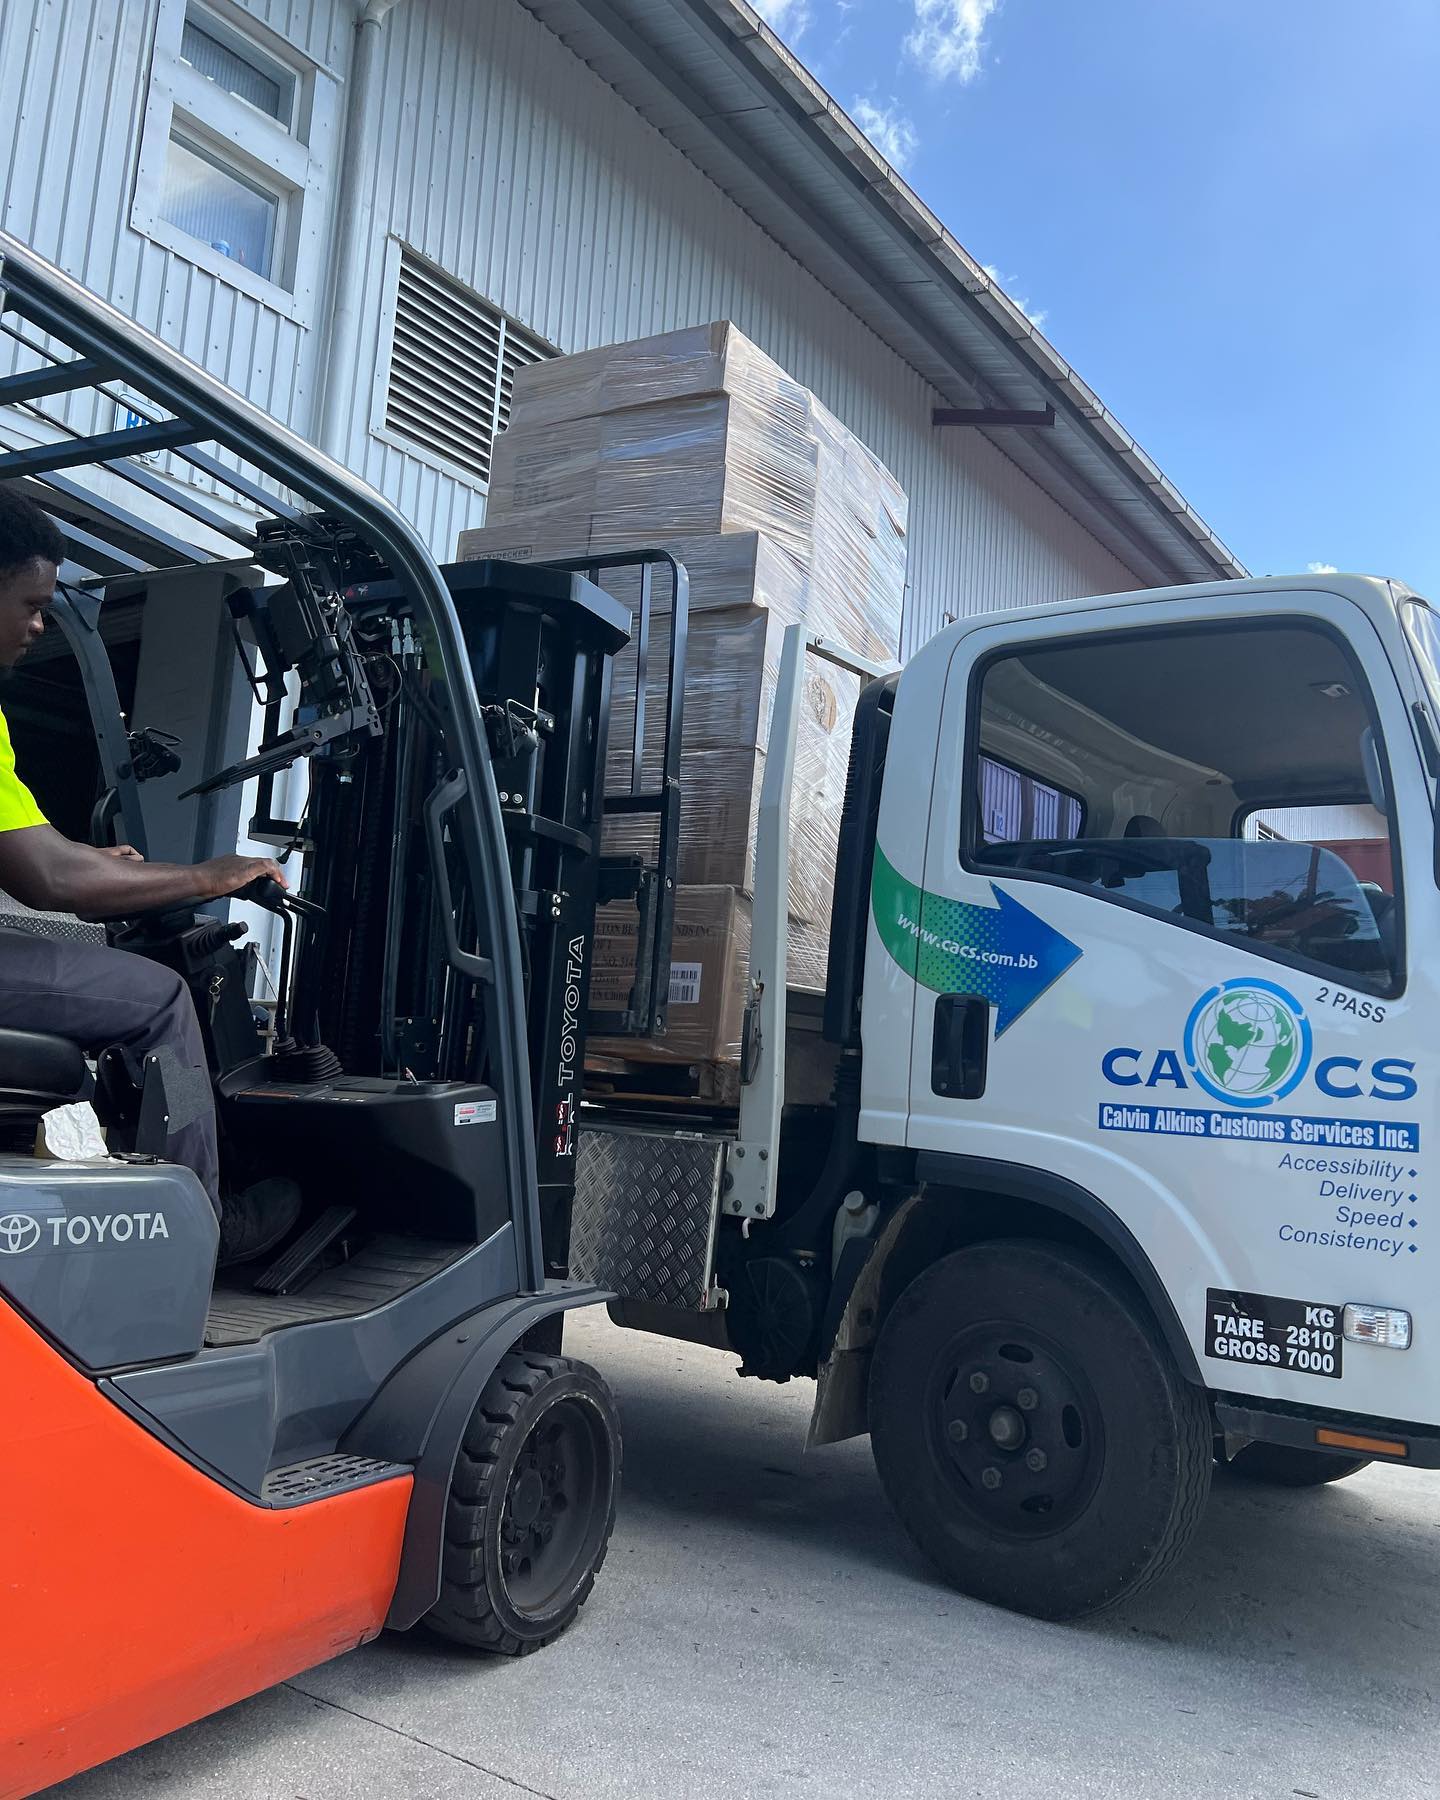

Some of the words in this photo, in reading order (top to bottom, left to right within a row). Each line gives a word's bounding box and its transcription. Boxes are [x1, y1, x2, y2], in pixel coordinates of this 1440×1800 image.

[897, 913, 1038, 969] www.cacs.com.bb
[558, 935, 585, 1087] TOYOTA
[1315, 987, 1329, 1003] 2
[1332, 991, 1386, 1023] PASS
[1102, 1105, 1150, 1130] Calvin
[1154, 1109, 1206, 1134] Alkins
[1210, 1113, 1286, 1140] Customs
[1290, 1119, 1375, 1146] Services
[1379, 1125, 1415, 1149] Inc.
[1278, 1153, 1404, 1182] Accessibility
[1319, 1180, 1404, 1207] Delivery
[47, 1212, 169, 1246] TOYOTA
[1336, 1206, 1404, 1228] Speed
[1279, 1224, 1404, 1257] Consistency
[1213, 1314, 1264, 1338] TARE
[1286, 1325, 1335, 1351] 2810
[1305, 1306, 1335, 1328] KG
[1214, 1336, 1281, 1363] GROSS
[1286, 1347, 1335, 1373] 7000
